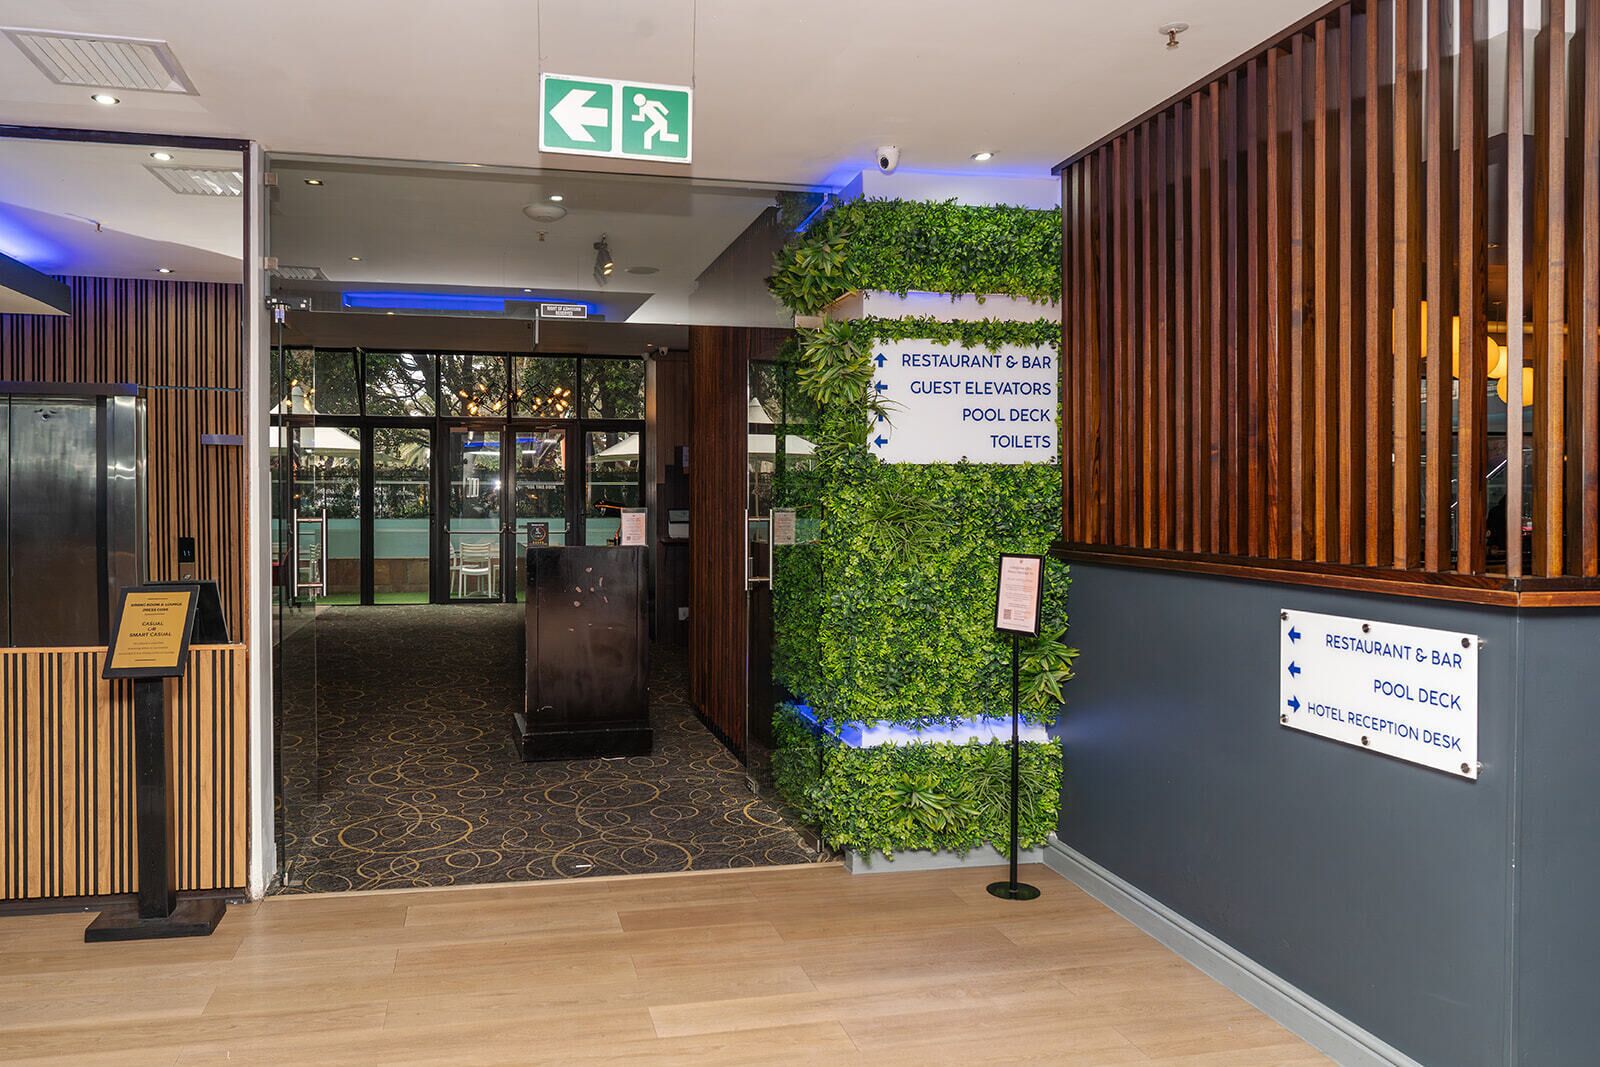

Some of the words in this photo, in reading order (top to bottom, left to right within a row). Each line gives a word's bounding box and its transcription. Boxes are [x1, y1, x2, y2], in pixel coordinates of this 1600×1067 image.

[902, 353, 1002, 368] RESTAURANT
[1006, 355, 1018, 370] &
[1022, 355, 1052, 369] BAR
[910, 380, 961, 394] GUEST
[965, 382, 1052, 396] ELEVATORS
[962, 408, 1006, 422] POOL
[1010, 408, 1051, 422] DECK
[990, 435, 1051, 448] TOILETS
[1326, 634, 1412, 661] RESTAURANT
[1415, 648, 1428, 662] &
[1432, 650, 1462, 669] BAR
[1374, 680, 1414, 701] POOL
[1418, 688, 1462, 711] DECK
[1308, 702, 1344, 722] HOTEL
[1348, 712, 1418, 741] RECEPTION
[1423, 730, 1462, 752] DESK
